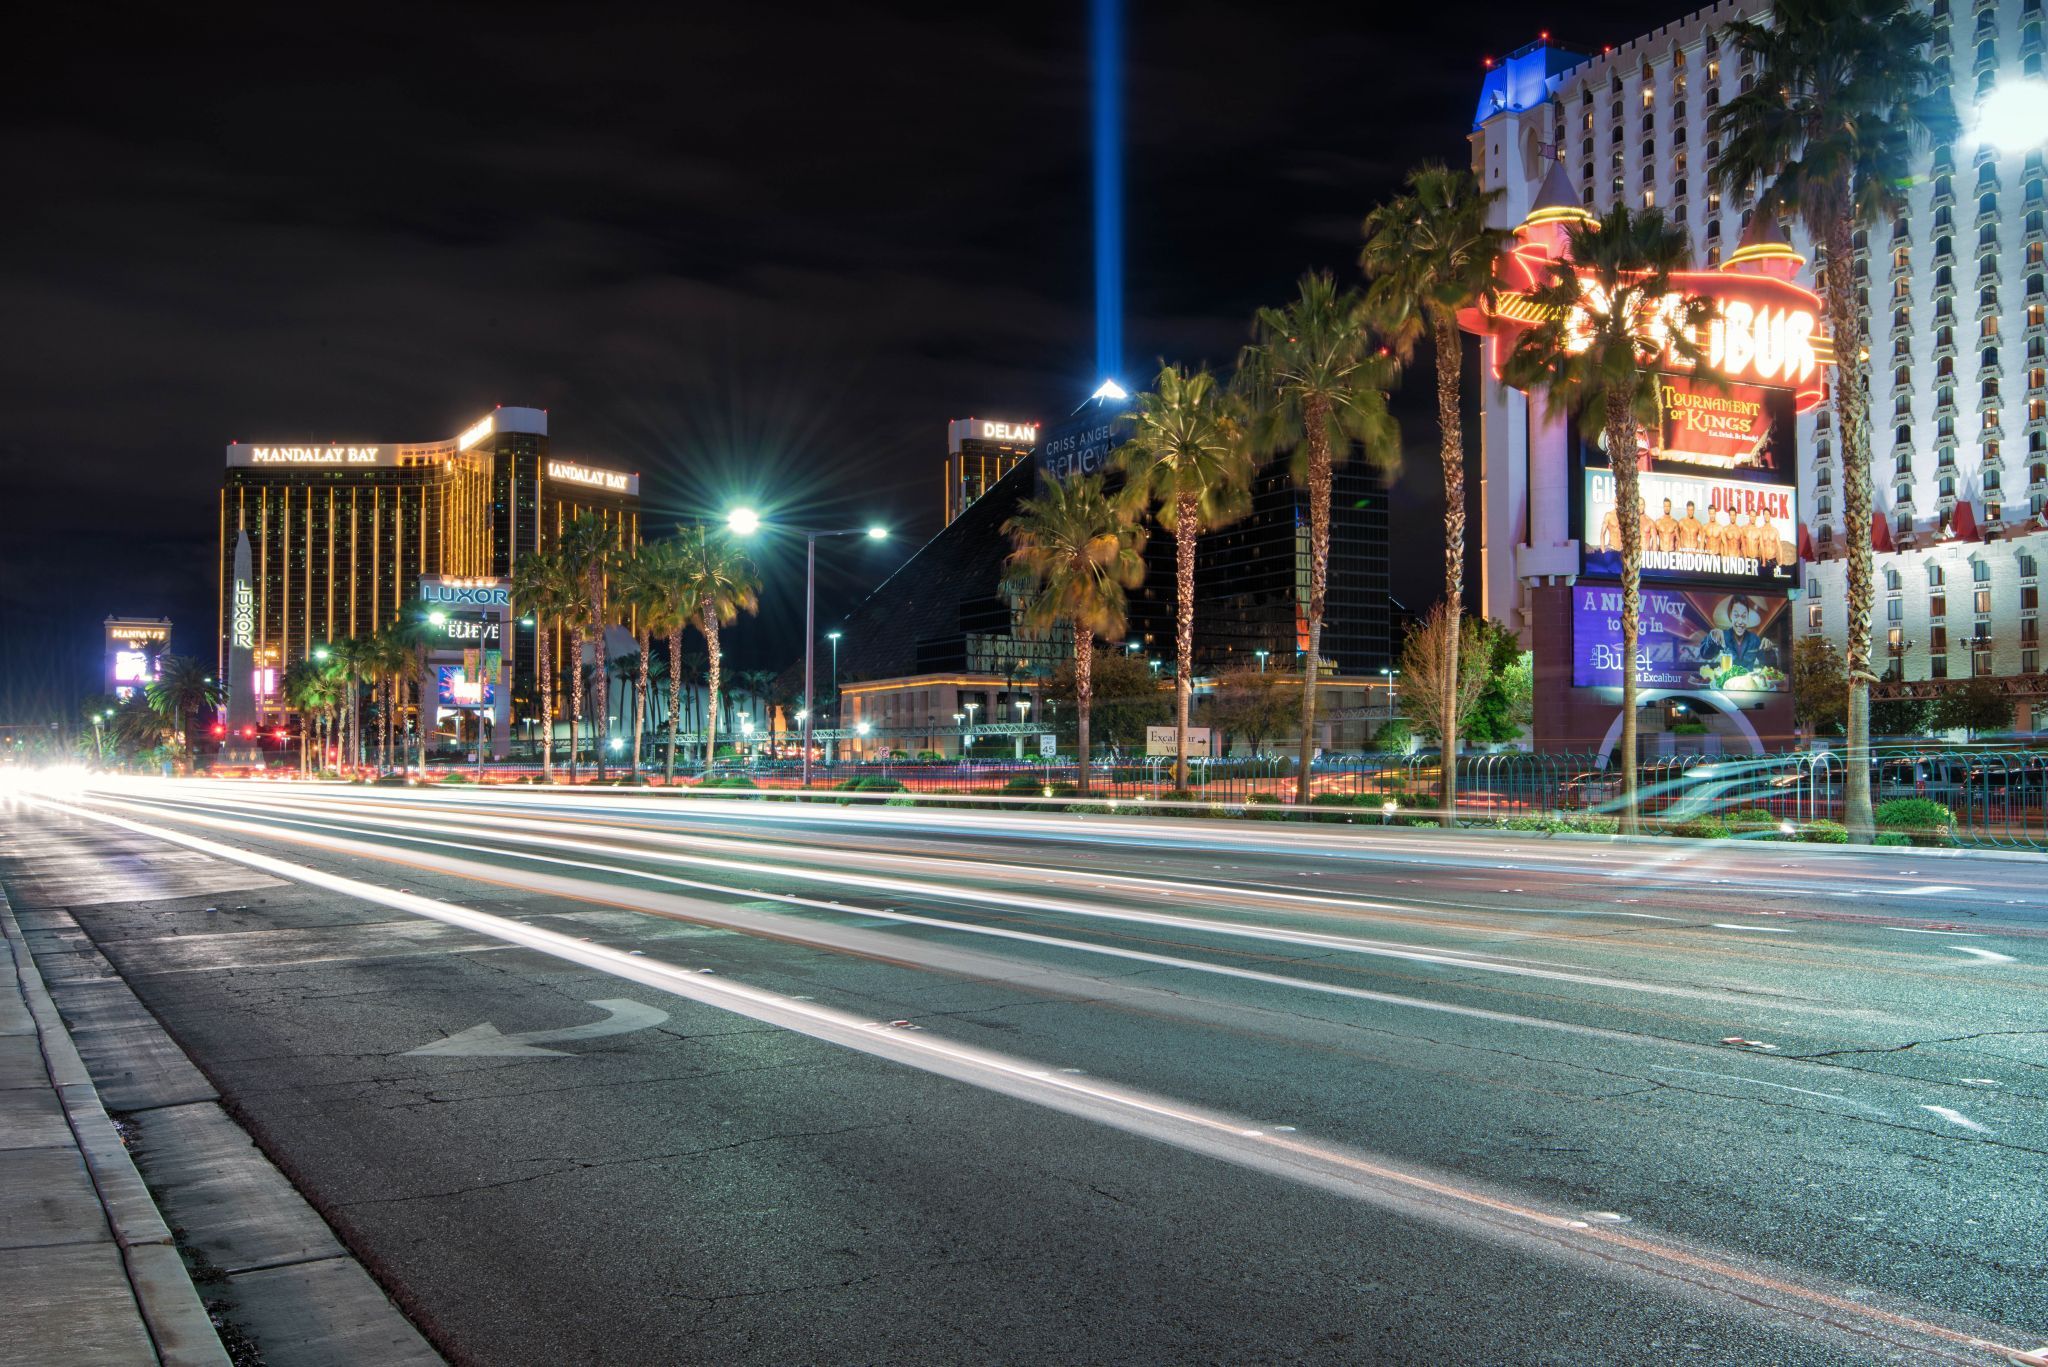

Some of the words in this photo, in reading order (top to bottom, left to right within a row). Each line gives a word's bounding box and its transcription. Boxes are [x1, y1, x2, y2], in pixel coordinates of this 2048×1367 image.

[1661, 386, 1760, 416] TOURNAMENT
[1686, 408, 1752, 432] KINGS
[984, 422, 1035, 441] DELAN
[1046, 436, 1075, 455] CRISS
[1080, 424, 1115, 445] ANGEL
[253, 448, 344, 462] MANDALAY
[347, 448, 378, 462] BAY
[607, 476, 627, 489] BAY
[1711, 487, 1790, 519] OUTBACK
[1721, 556, 1759, 576] UNDER
[424, 586, 510, 606] LUXOR
[236, 579, 252, 648] LUXOR
[1584, 592, 1597, 610] A
[1651, 595, 1686, 625] Way
[1650, 617, 1664, 632] In
[1596, 644, 1653, 671] Buet
[1643, 673, 1681, 684] Excalibur
[1042, 745, 1055, 754] 45
